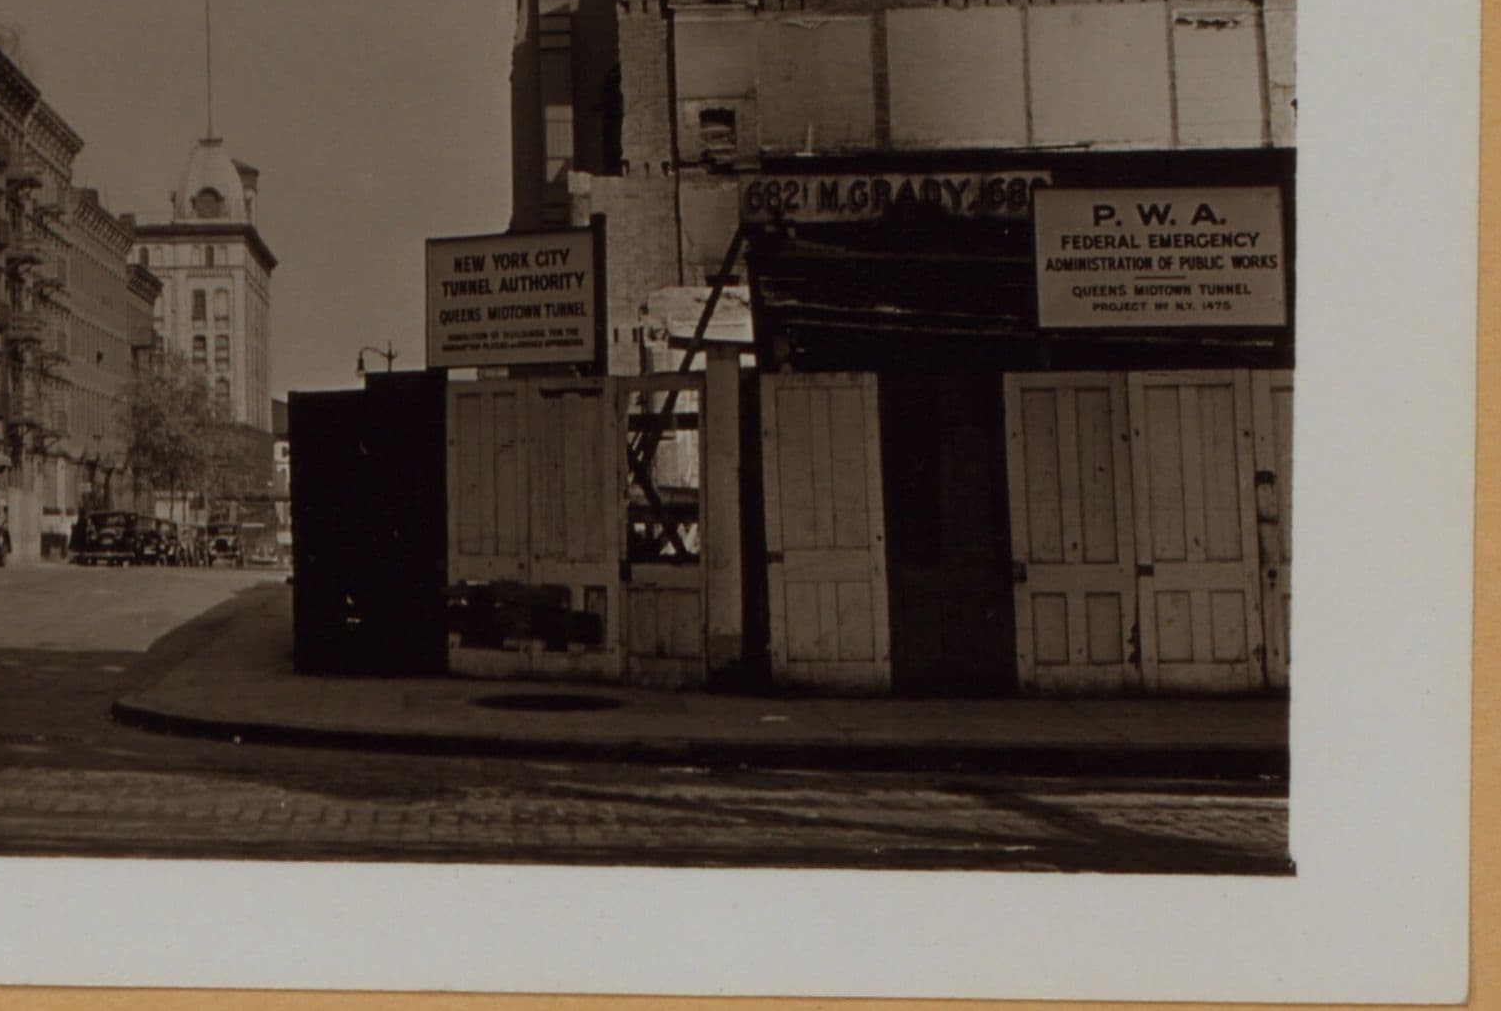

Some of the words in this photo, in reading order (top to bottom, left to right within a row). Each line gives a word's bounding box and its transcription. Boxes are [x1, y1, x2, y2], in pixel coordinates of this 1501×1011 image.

[1093, 203, 1122, 227] P.
[1136, 202, 1177, 227] W.
[1191, 202, 1227, 226] A.
[1061, 234, 1141, 250] FEDERAL
[1147, 232, 1260, 249] EMERGENCY
[453, 255, 486, 273] NEW
[491, 251, 531, 271] YORK
[534, 248, 570, 269] CITY
[1045, 257, 1153, 272] ADMINISTRATION
[1156, 256, 1175, 271] OF
[1180, 255, 1225, 270] PUBLIC
[1230, 254, 1279, 270] WORKS
[441, 278, 493, 297] TUNNEL
[498, 271, 586, 294] AUTHORITY
[1071, 285, 1127, 298] QUEENS
[1134, 284, 1192, 296] MIDTOWN
[1198, 283, 1253, 296] TUNNEL
[439, 308, 483, 325] QUEENS
[487, 304, 541, 321] MIDTOWN
[543, 301, 588, 319] TUNNEL
[1092, 301, 1148, 311] PROJECT
